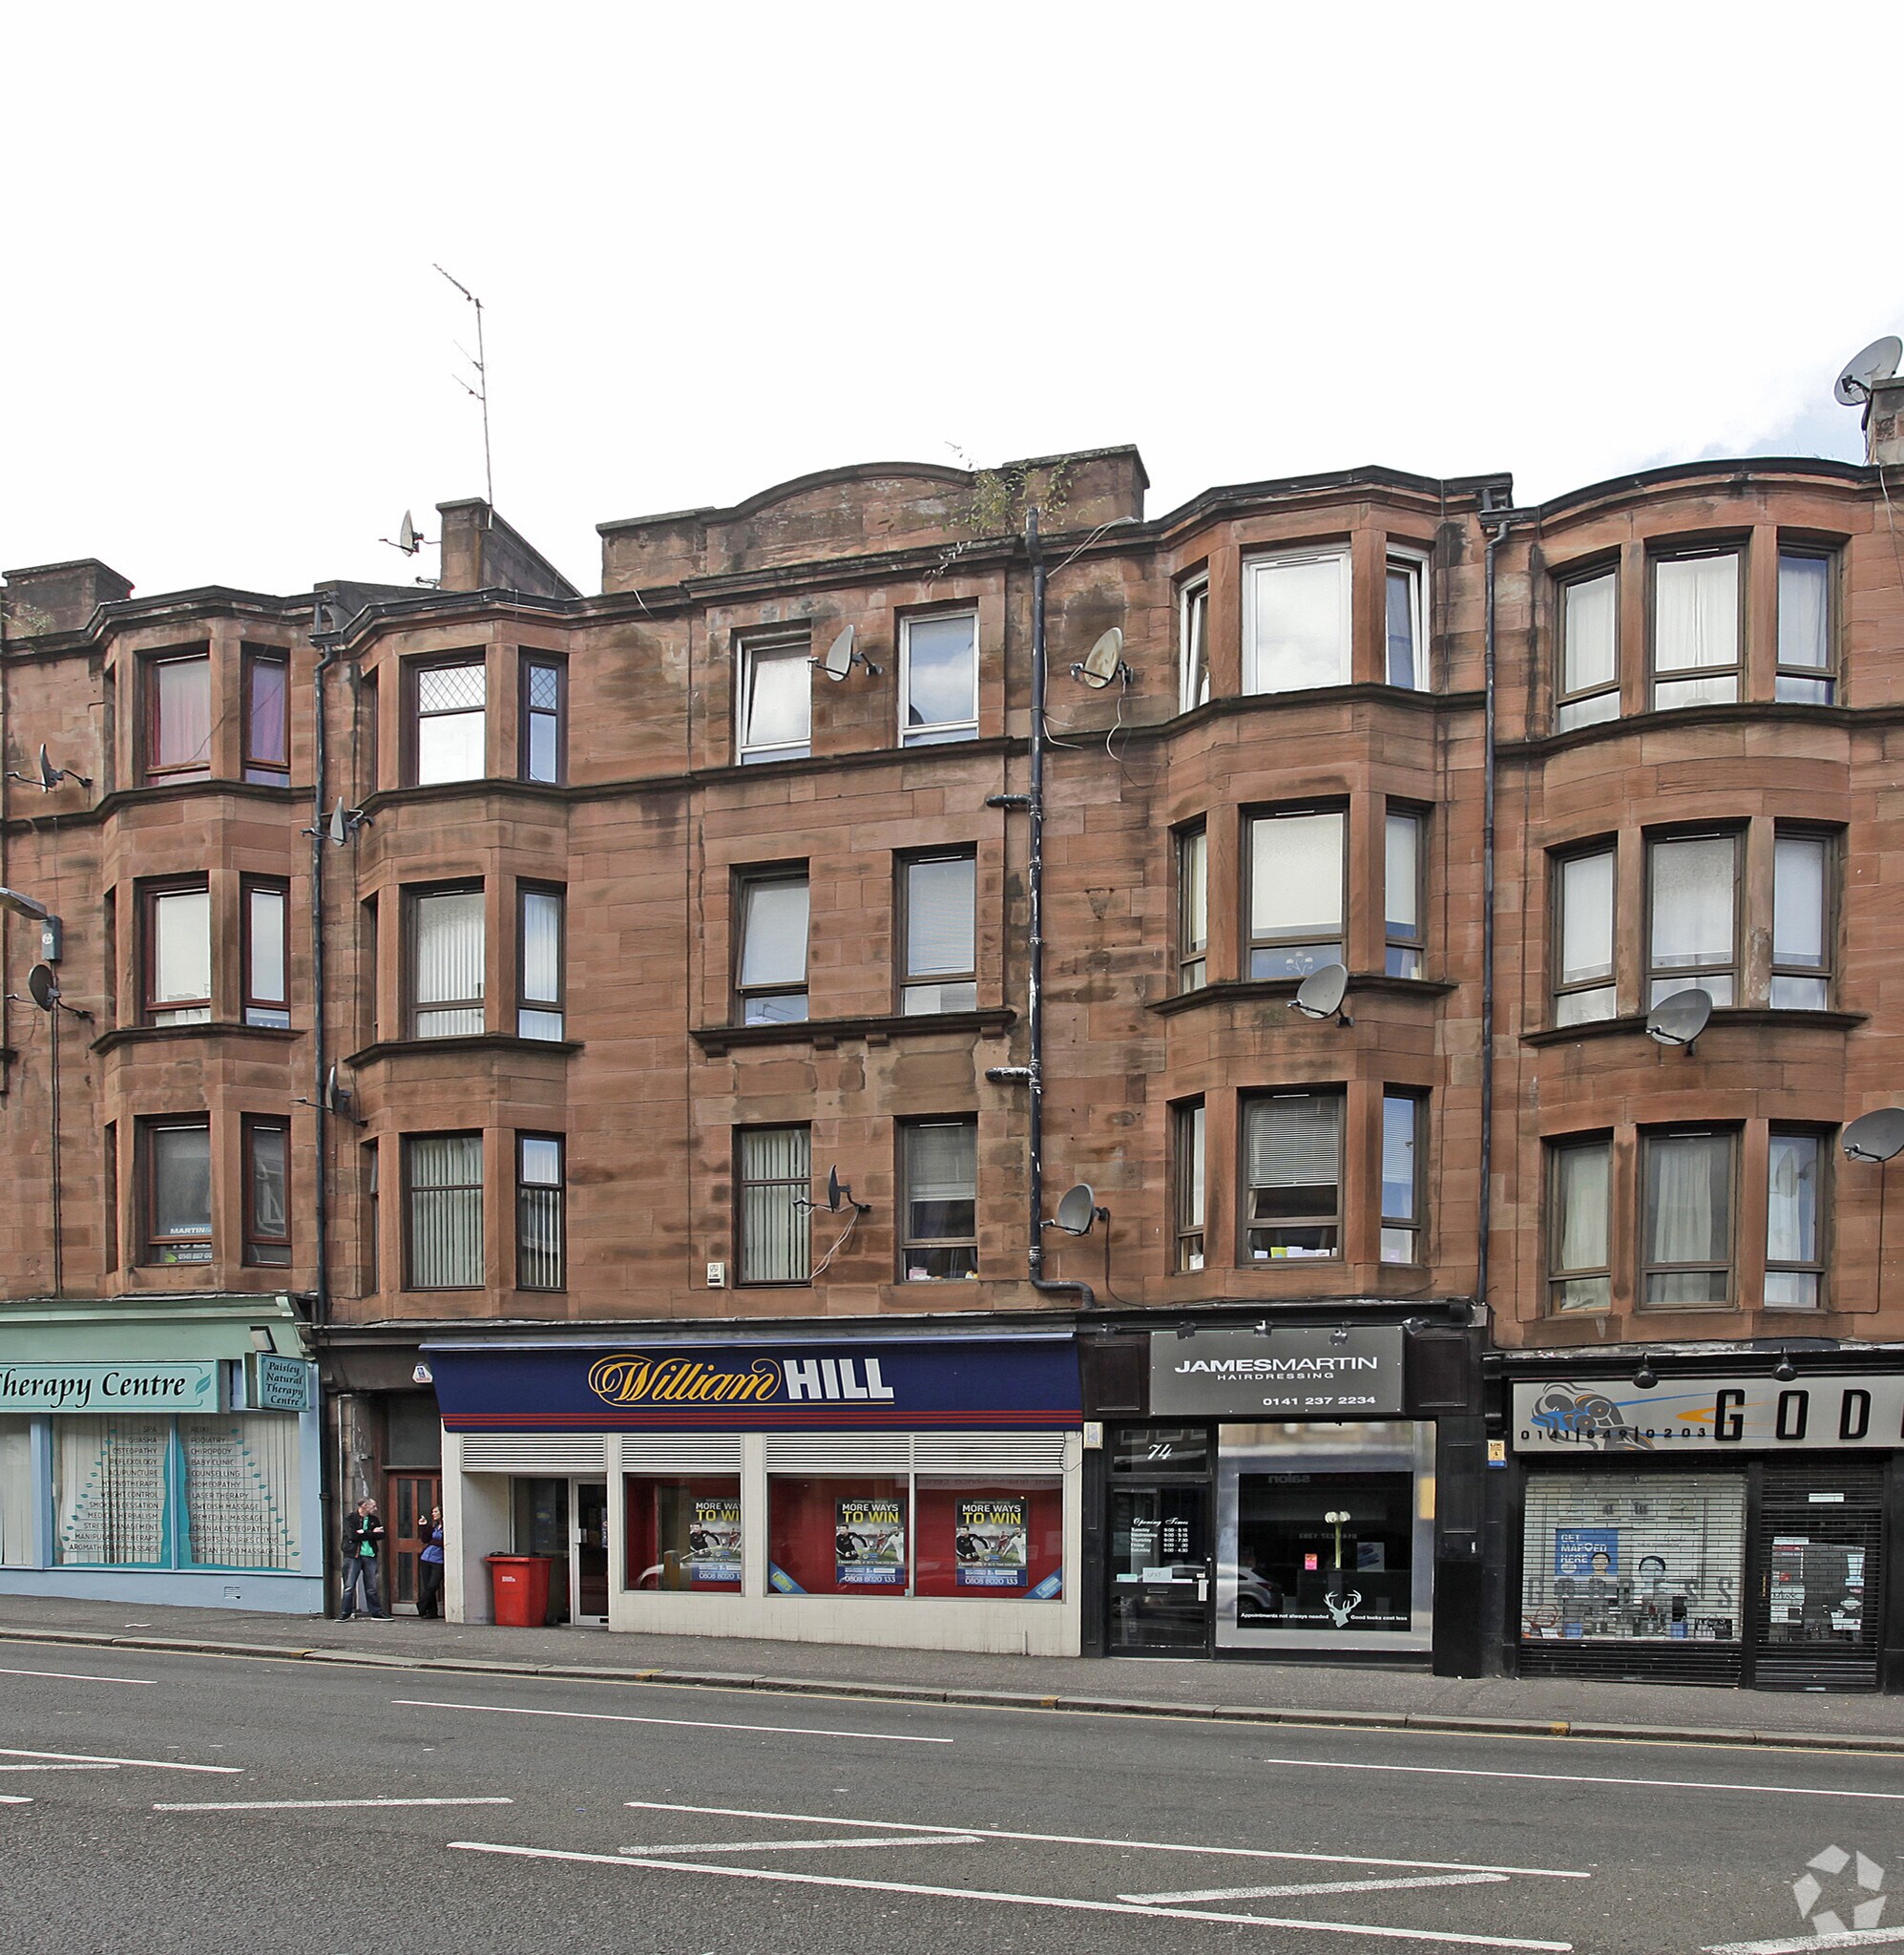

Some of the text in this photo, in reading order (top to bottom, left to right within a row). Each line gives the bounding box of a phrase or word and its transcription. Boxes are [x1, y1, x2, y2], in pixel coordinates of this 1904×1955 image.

[269, 1362, 300, 1377] Paisley
[1175, 1357, 1378, 1373] JAMESMARTIN
[266, 1372, 304, 1385] Natural
[588, 1354, 894, 1401] William HILL
[0, 1368, 186, 1408] herapy Centre
[266, 1383, 303, 1399] Therapy
[270, 1395, 299, 1406] Centre
[1338, 1396, 1376, 1404] 2234
[1714, 1388, 1904, 1441] GOD
[1147, 1444, 1172, 1460] 74
[695, 1510, 739, 1521] TO WI
[842, 1511, 899, 1523] TO WIN
[962, 1512, 1021, 1524] TO WIN
[1133, 1518, 1161, 1527] Opening
[1561, 1534, 1580, 1543] GET
[1560, 1554, 1588, 1563] HERE
